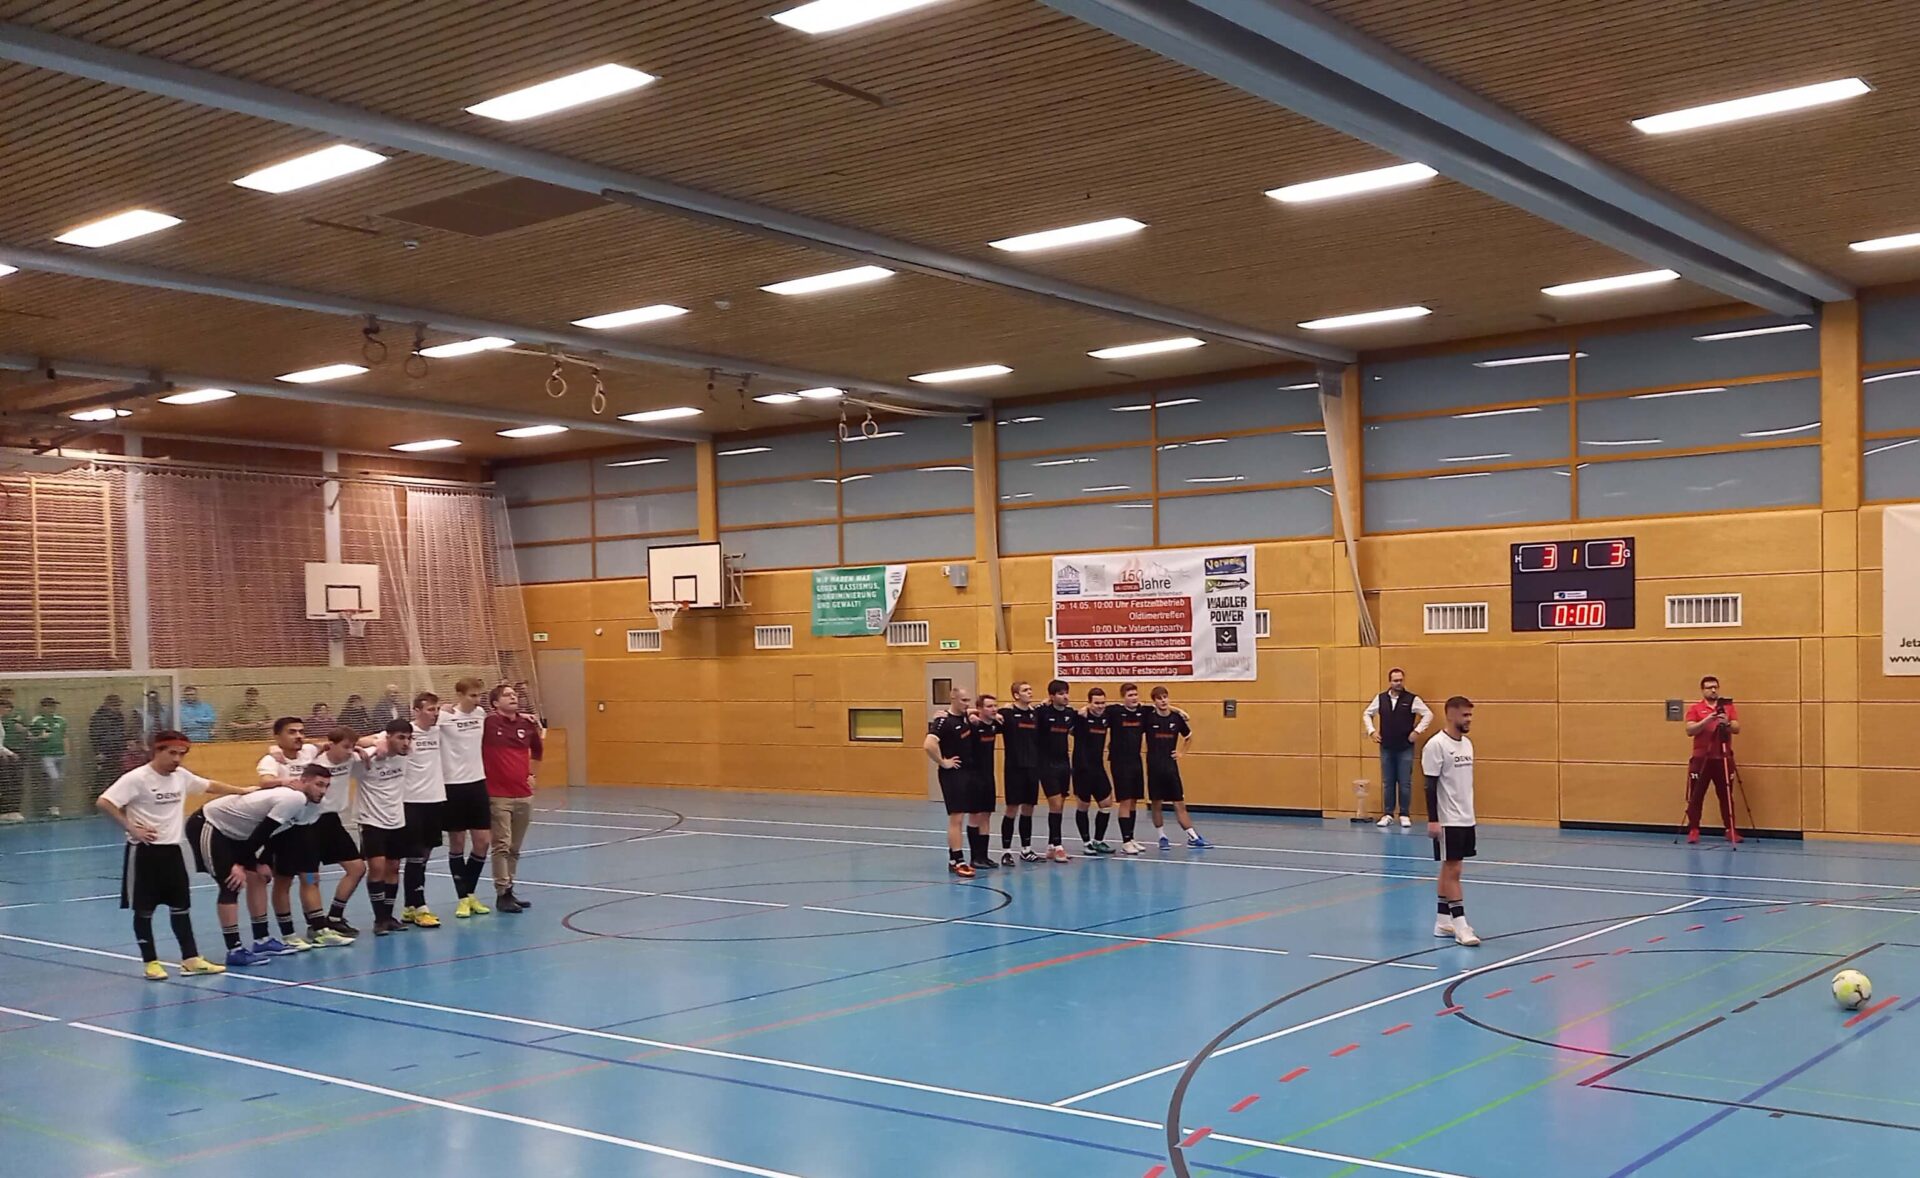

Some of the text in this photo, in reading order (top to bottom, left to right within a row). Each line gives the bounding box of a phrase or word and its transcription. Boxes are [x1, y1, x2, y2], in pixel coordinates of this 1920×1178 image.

[1515, 555, 1522, 563] H
[1543, 547, 1555, 568] 3
[1610, 544, 1622, 564] 3
[1623, 549, 1631, 558] G
[1140, 578, 1171, 590] Jahre
[1094, 600, 1113, 609] 10:00
[1115, 600, 1130, 608] Uhr
[1130, 598, 1185, 608] Festzeltbetrieb
[1210, 609, 1244, 622] POWER
[1555, 604, 1602, 626] 0:00
[1113, 624, 1127, 632] Uhr
[1129, 624, 1184, 634] Vatertagsparty
[1115, 638, 1130, 647] Uhr
[1130, 637, 1186, 647] Festzeltbetrieb
[1116, 652, 1130, 661] Uhr
[1131, 651, 1186, 660] Festzeltbetrieb
[1116, 666, 1130, 674] Uhr
[1132, 666, 1178, 677] Festsonntag
